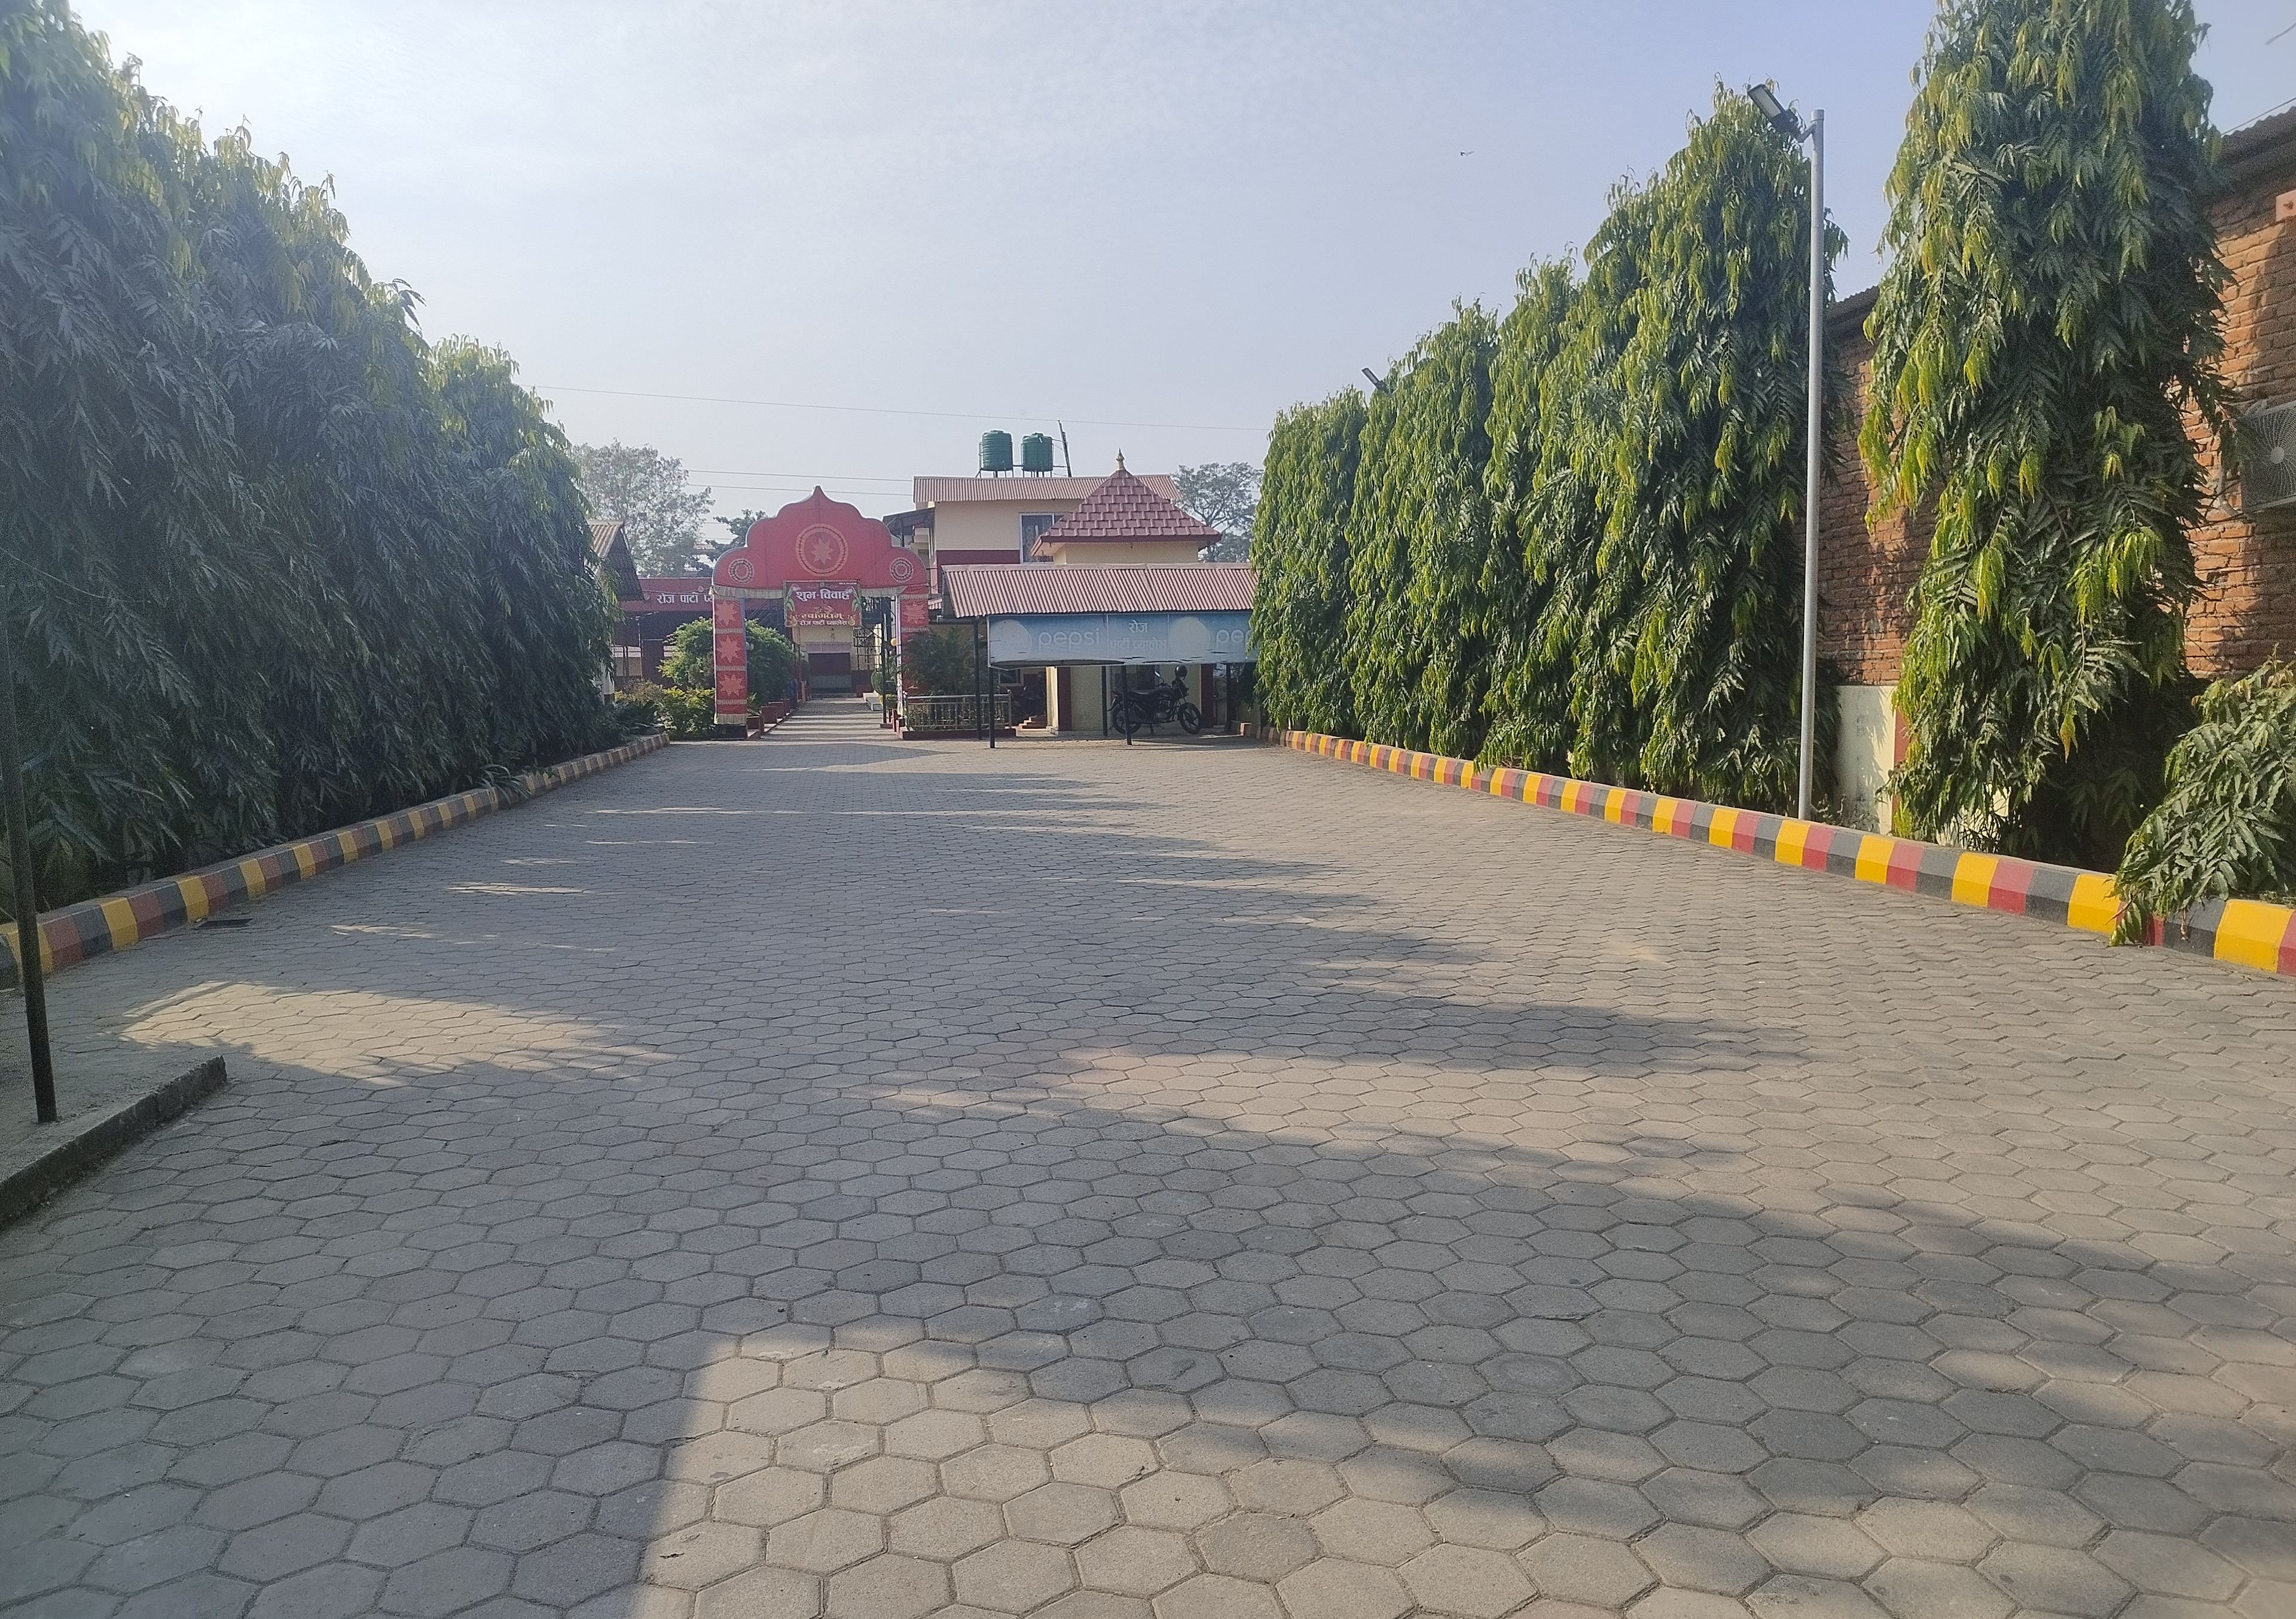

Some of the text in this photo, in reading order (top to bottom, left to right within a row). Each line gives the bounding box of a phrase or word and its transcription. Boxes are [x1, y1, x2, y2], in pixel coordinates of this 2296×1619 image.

[657, 593, 675, 603] रोज
[1129, 620, 1148, 632] रोज
[1039, 628, 1100, 650] pepsi
